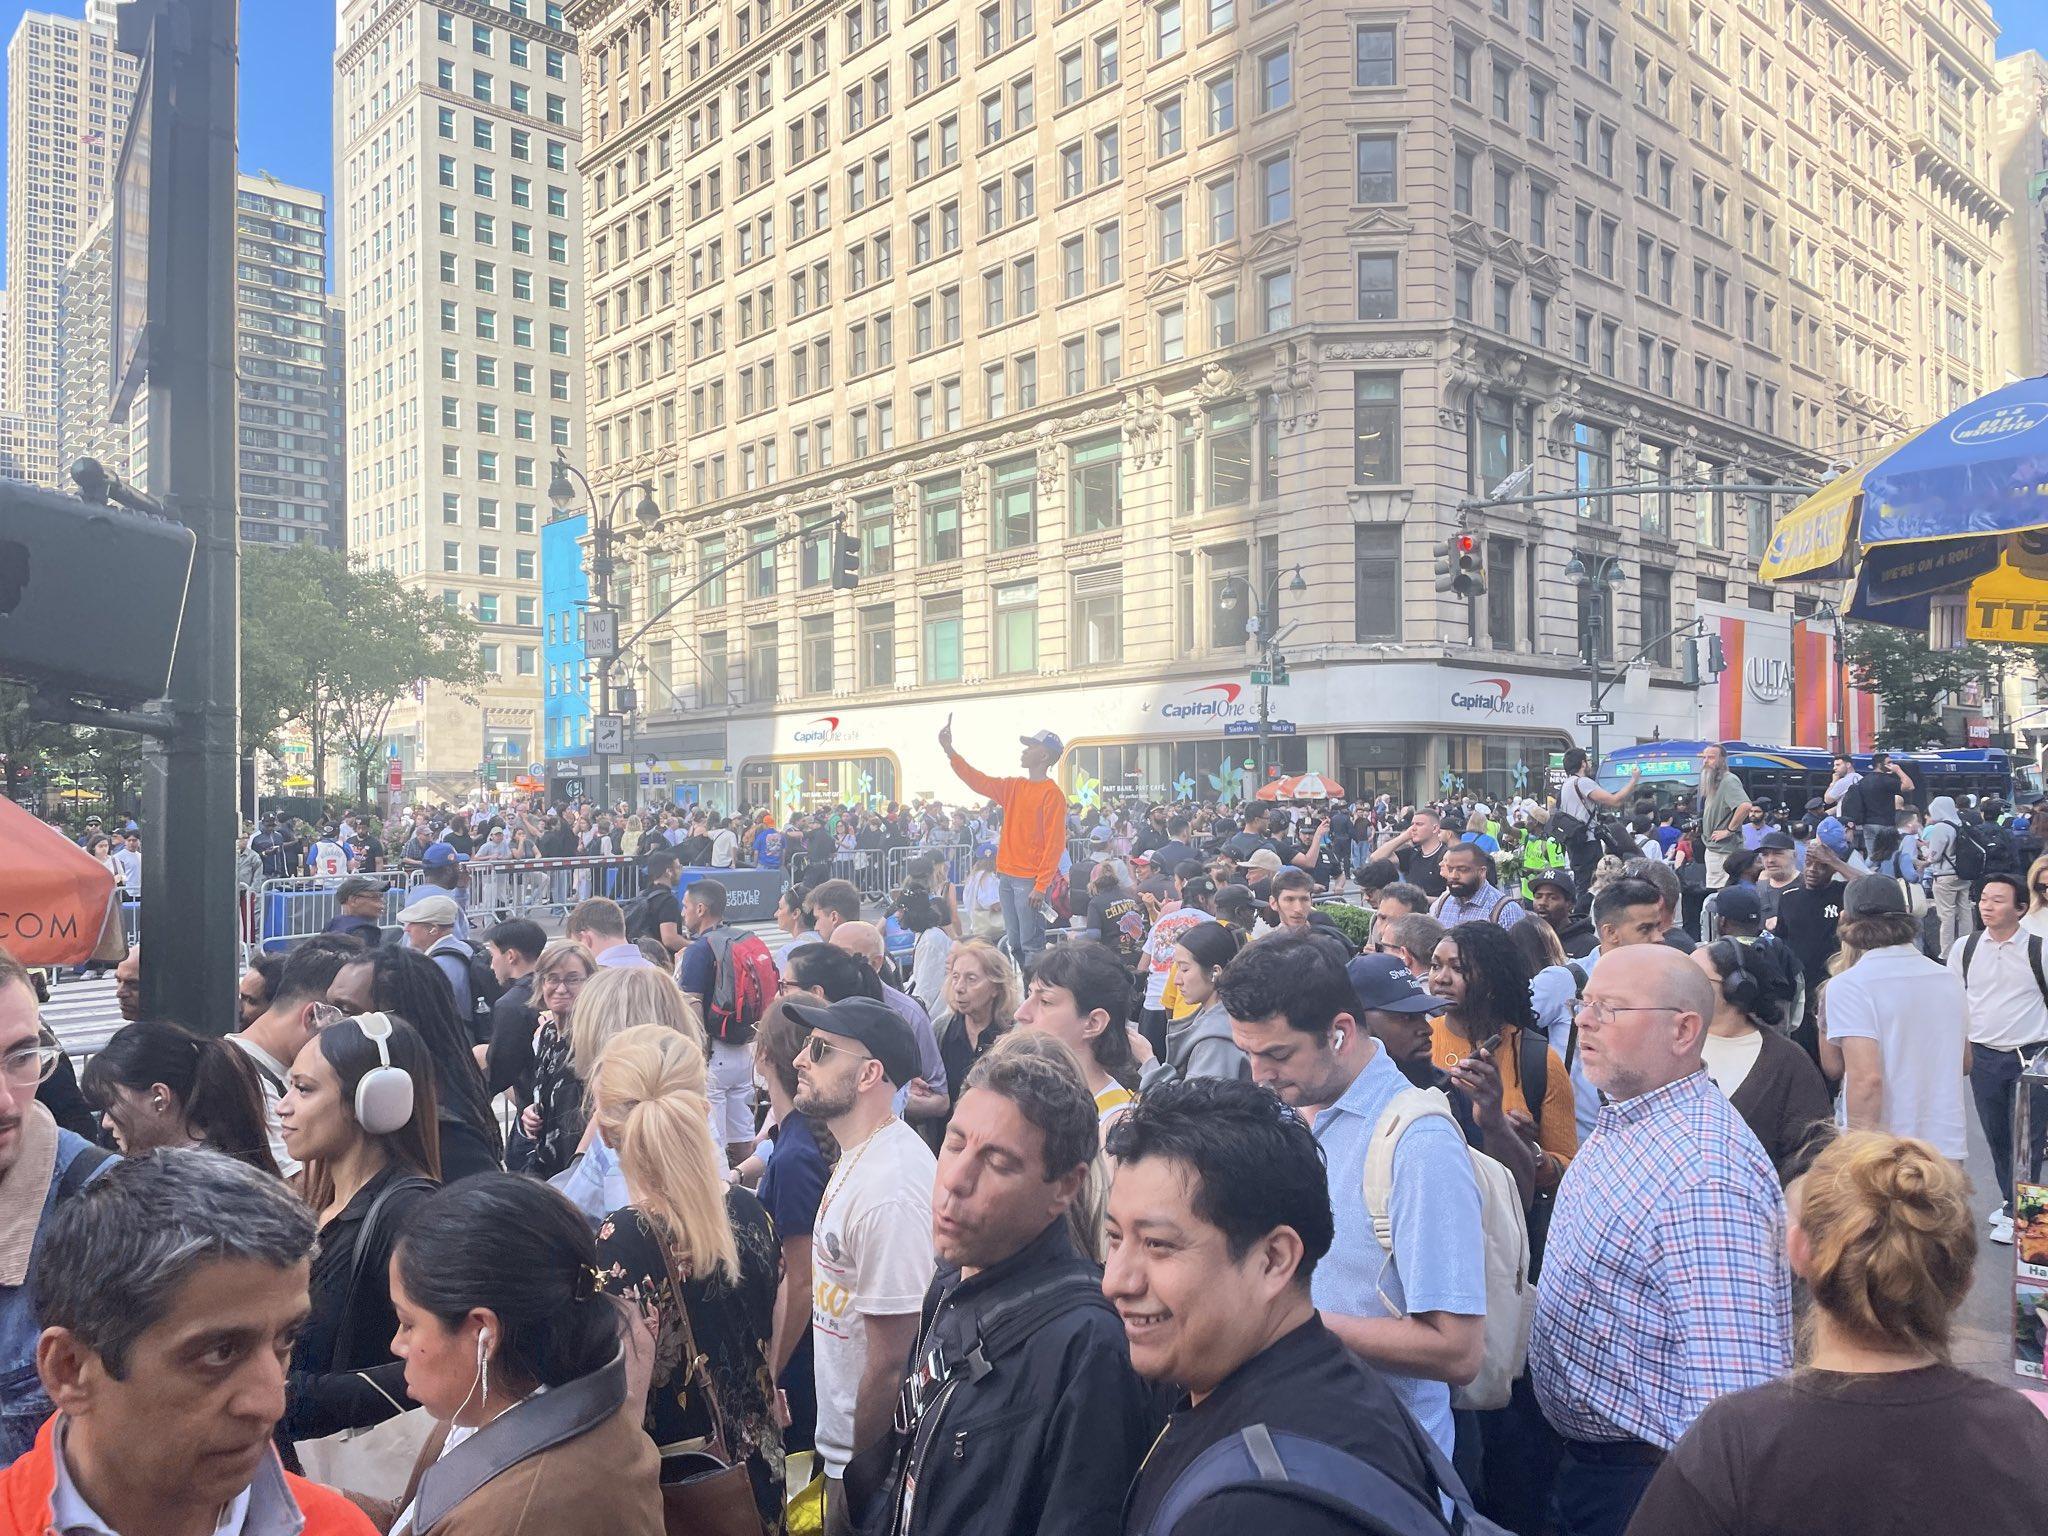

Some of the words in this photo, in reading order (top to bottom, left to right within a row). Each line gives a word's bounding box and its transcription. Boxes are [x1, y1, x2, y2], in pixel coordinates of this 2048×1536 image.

[592, 619, 606, 633] NO
[588, 638, 611, 650] TURNS
[1752, 656, 1791, 690] ULTA
[598, 742, 618, 750] RIGHT
[326, 859, 337, 874] 5
[726, 898, 760, 907] SQUARE
[1824, 904, 1839, 918] NY
